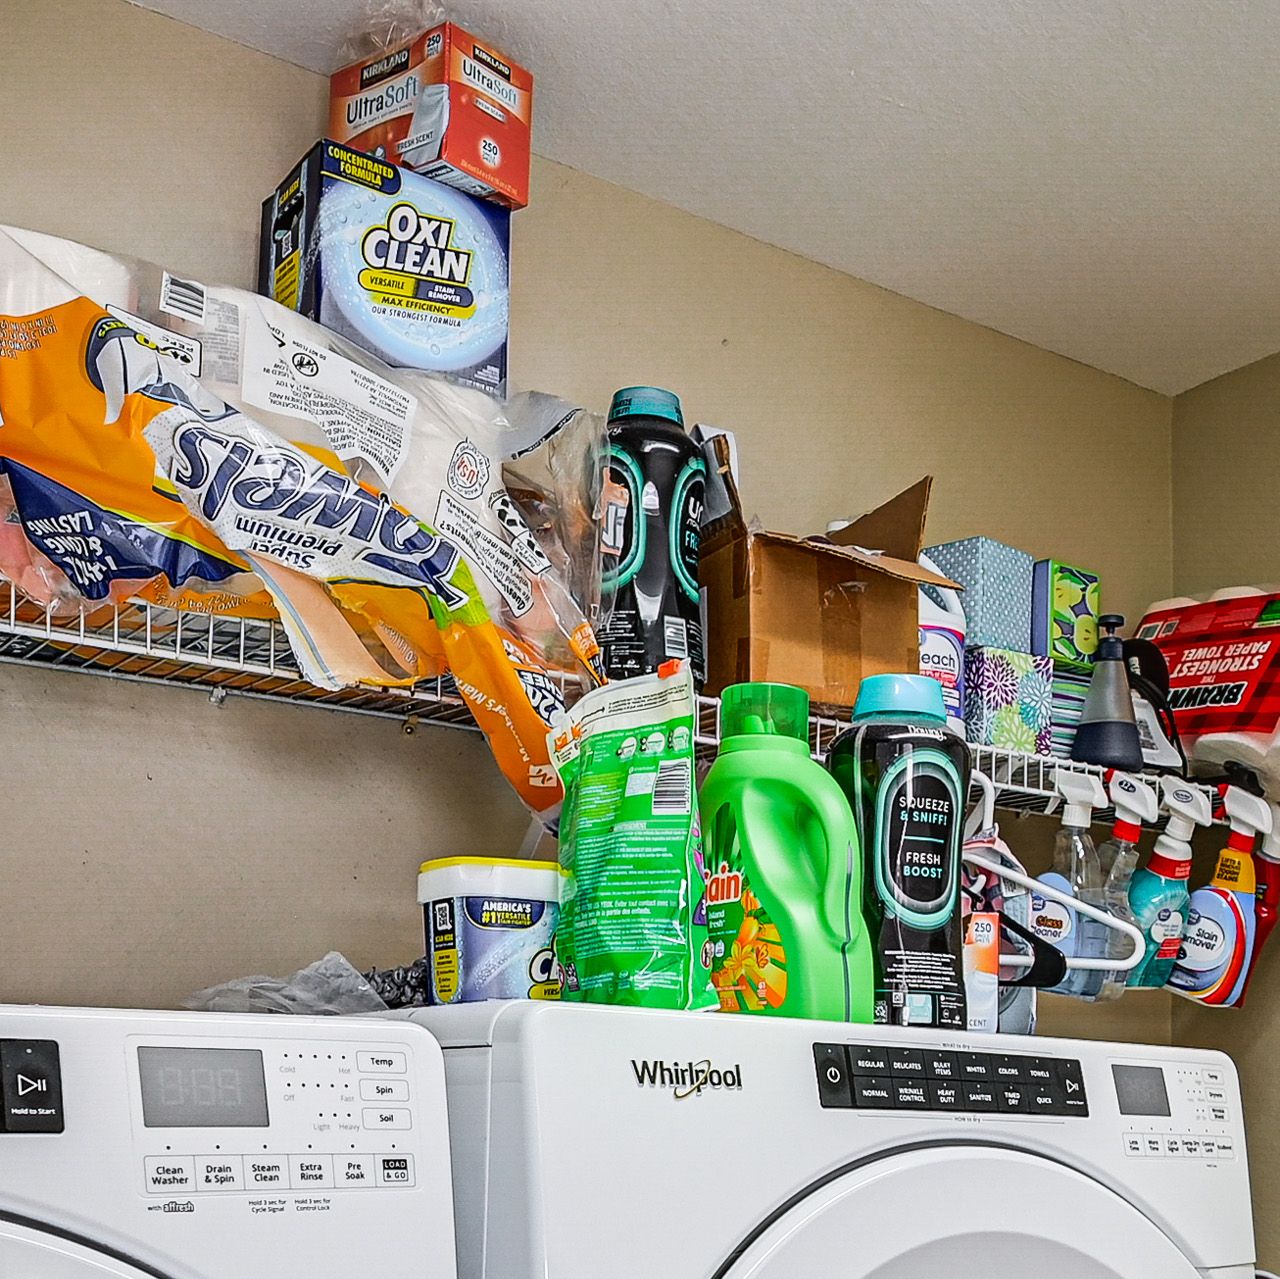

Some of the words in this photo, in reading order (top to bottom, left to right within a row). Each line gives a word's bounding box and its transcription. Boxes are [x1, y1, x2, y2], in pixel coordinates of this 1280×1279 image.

[426, 34, 441, 48] 250
[362, 50, 409, 79] KIRKLAND
[474, 47, 510, 75] KIRKLAND
[463, 58, 517, 105] UltraSoft
[346, 76, 419, 124] UltraSoft
[482, 140, 498, 155] 250
[327, 145, 394, 179] CONCENTRATED
[340, 162, 382, 186] FORMULA
[388, 204, 451, 249] OXI
[363, 228, 469, 283] CLEAN
[369, 275, 406, 290] VERSATILE
[434, 284, 455, 295] STAIN
[381, 295, 403, 307] MAX
[428, 291, 461, 303] REMOVER
[371, 306, 387, 316] OUR
[389, 308, 428, 322] STRONGEST
[429, 312, 462, 328] FORMULA
[455, 455, 476, 485] USA
[170, 423, 468, 608] Towels
[26, 510, 94, 536] LASTING
[234, 515, 344, 558] premium
[43, 535, 89, 557] LONG
[249, 540, 317, 571] Super
[1182, 645, 1224, 661] TOWEL
[1225, 639, 1272, 656] PAPER
[920, 652, 956, 669] each
[1169, 653, 1263, 679] STRONGEST
[1200, 674, 1216, 683] THE
[453, 675, 487, 704] Mar
[898, 796, 950, 813] SQUEEZE
[900, 810, 908, 822] &
[912, 811, 948, 825] SNIFF!
[905, 851, 941, 865] FRESH
[903, 865, 943, 879] BOOST
[482, 900, 532, 914] AMERICA'S
[974, 922, 992, 933] 250
[1196, 928, 1218, 942] Stain
[969, 1018, 987, 1027] CENT
[370, 1057, 394, 1068] Temp
[857, 1060, 885, 1069] REGULAR
[893, 1061, 922, 1071] DELICATES
[933, 1061, 951, 1069] BULKY
[279, 1065, 296, 1074] Cold
[935, 1068, 952, 1076] ITEMS
[966, 1065, 987, 1074] WHITES
[998, 1067, 1019, 1076] COLORS
[1030, 1069, 1050, 1079] TOWELS
[630, 1058, 743, 1099] Whirlpool
[375, 1085, 394, 1096] Spin
[862, 1089, 889, 1098] NORMAL
[898, 1087, 923, 1096] WRINKLE
[937, 1088, 955, 1097] HEAVY
[898, 1094, 926, 1103] CONTROL
[939, 1095, 955, 1104] DUTY
[969, 1093, 992, 1102] SANITIZE
[1008, 1098, 1019, 1106] DRY
[1036, 1096, 1053, 1105] QUICK
[10, 1107, 28, 1116] Hold
[28, 1107, 37, 1116] to
[36, 1107, 56, 1116] Start
[378, 1113, 394, 1123] Soil
[205, 1164, 232, 1174] Drain
[251, 1163, 281, 1173] Steam
[300, 1162, 323, 1172] Extra
[347, 1161, 362, 1171] Pre
[384, 1160, 407, 1169] LOAD
[155, 1166, 184, 1176] Clean
[300, 1171, 324, 1181] Rinse
[345, 1170, 365, 1180] Soak
[385, 1171, 392, 1180] &
[394, 1171, 407, 1180] GO
[151, 1175, 189, 1185] Washer
[204, 1174, 213, 1184] &
[214, 1173, 235, 1185] Spin
[254, 1172, 280, 1182] Clean
[147, 1204, 162, 1212] with
